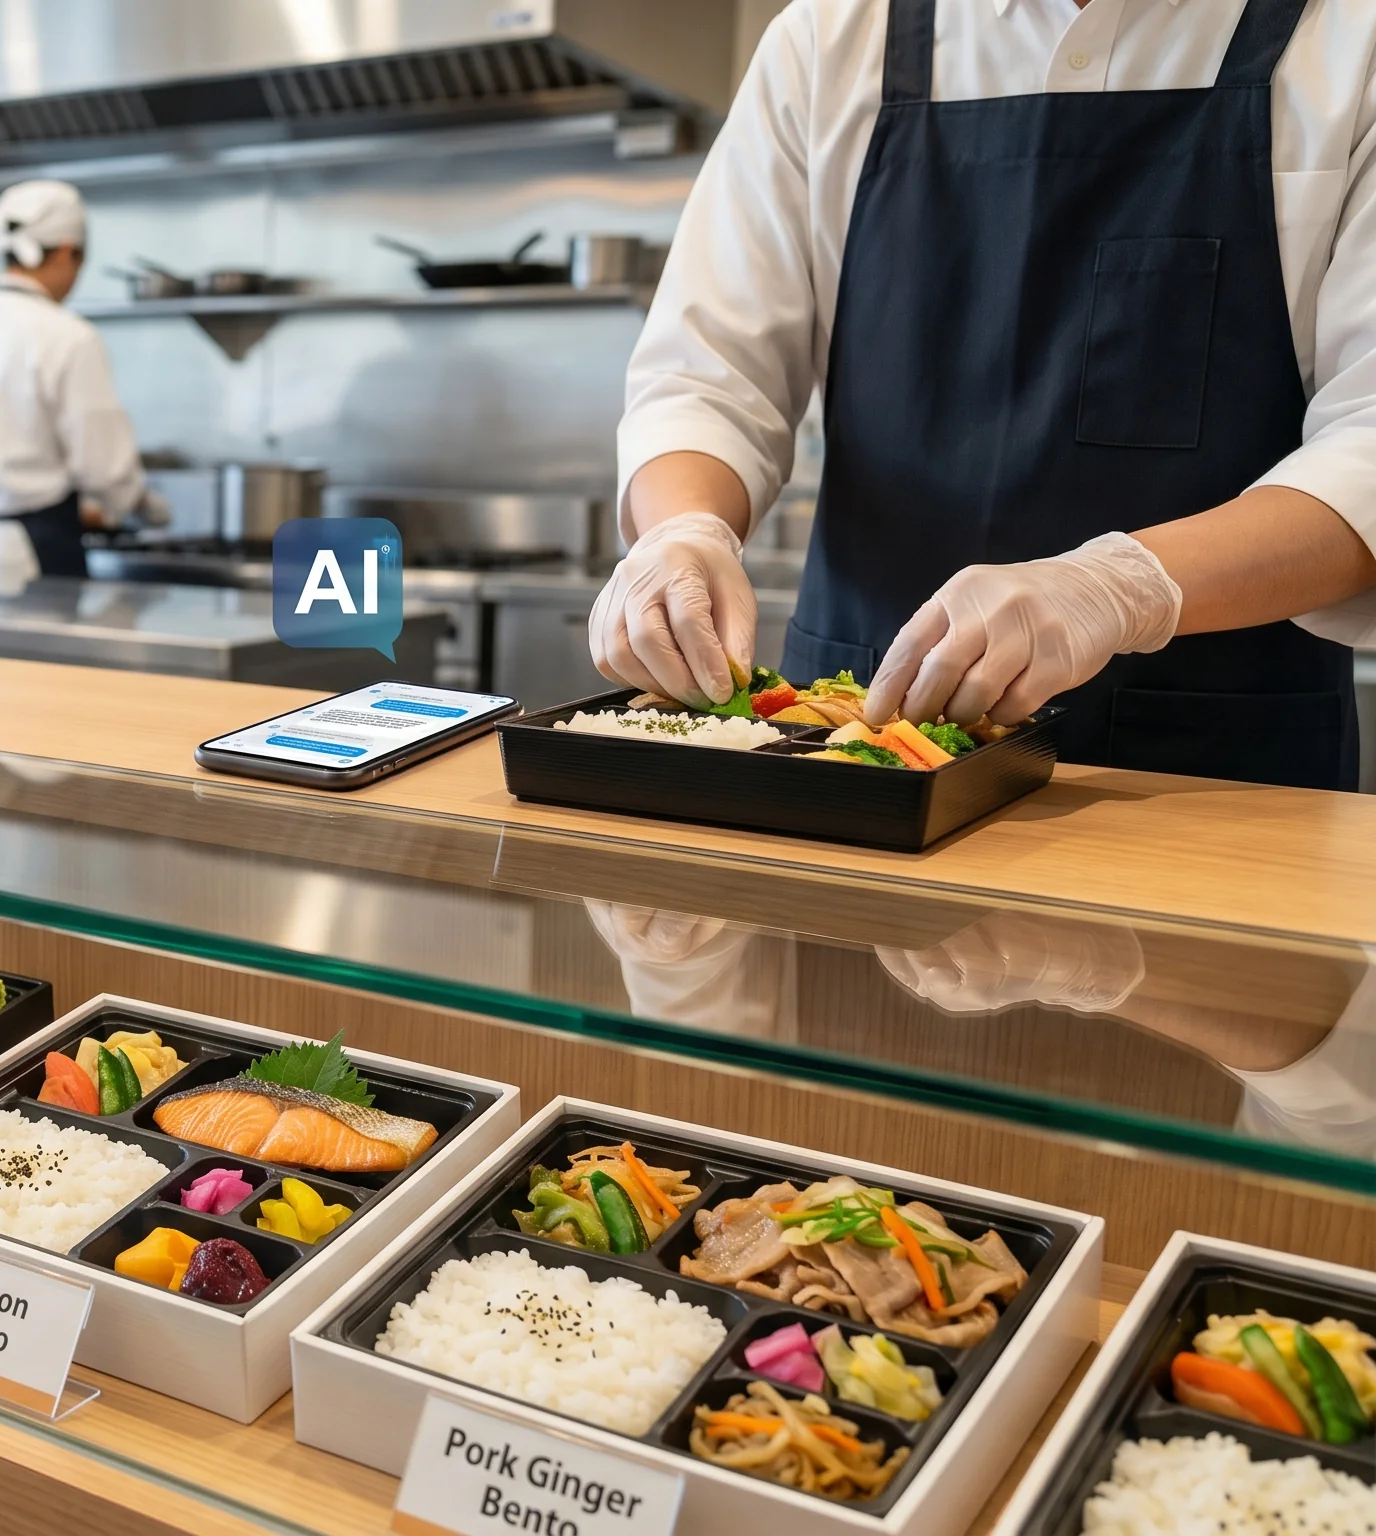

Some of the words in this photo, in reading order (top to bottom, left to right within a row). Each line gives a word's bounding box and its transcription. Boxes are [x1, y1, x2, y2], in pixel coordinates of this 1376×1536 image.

[443, 1426, 521, 1480] Pork
[526, 1455, 642, 1519] Ginger
[479, 1484, 580, 1536] Bento
